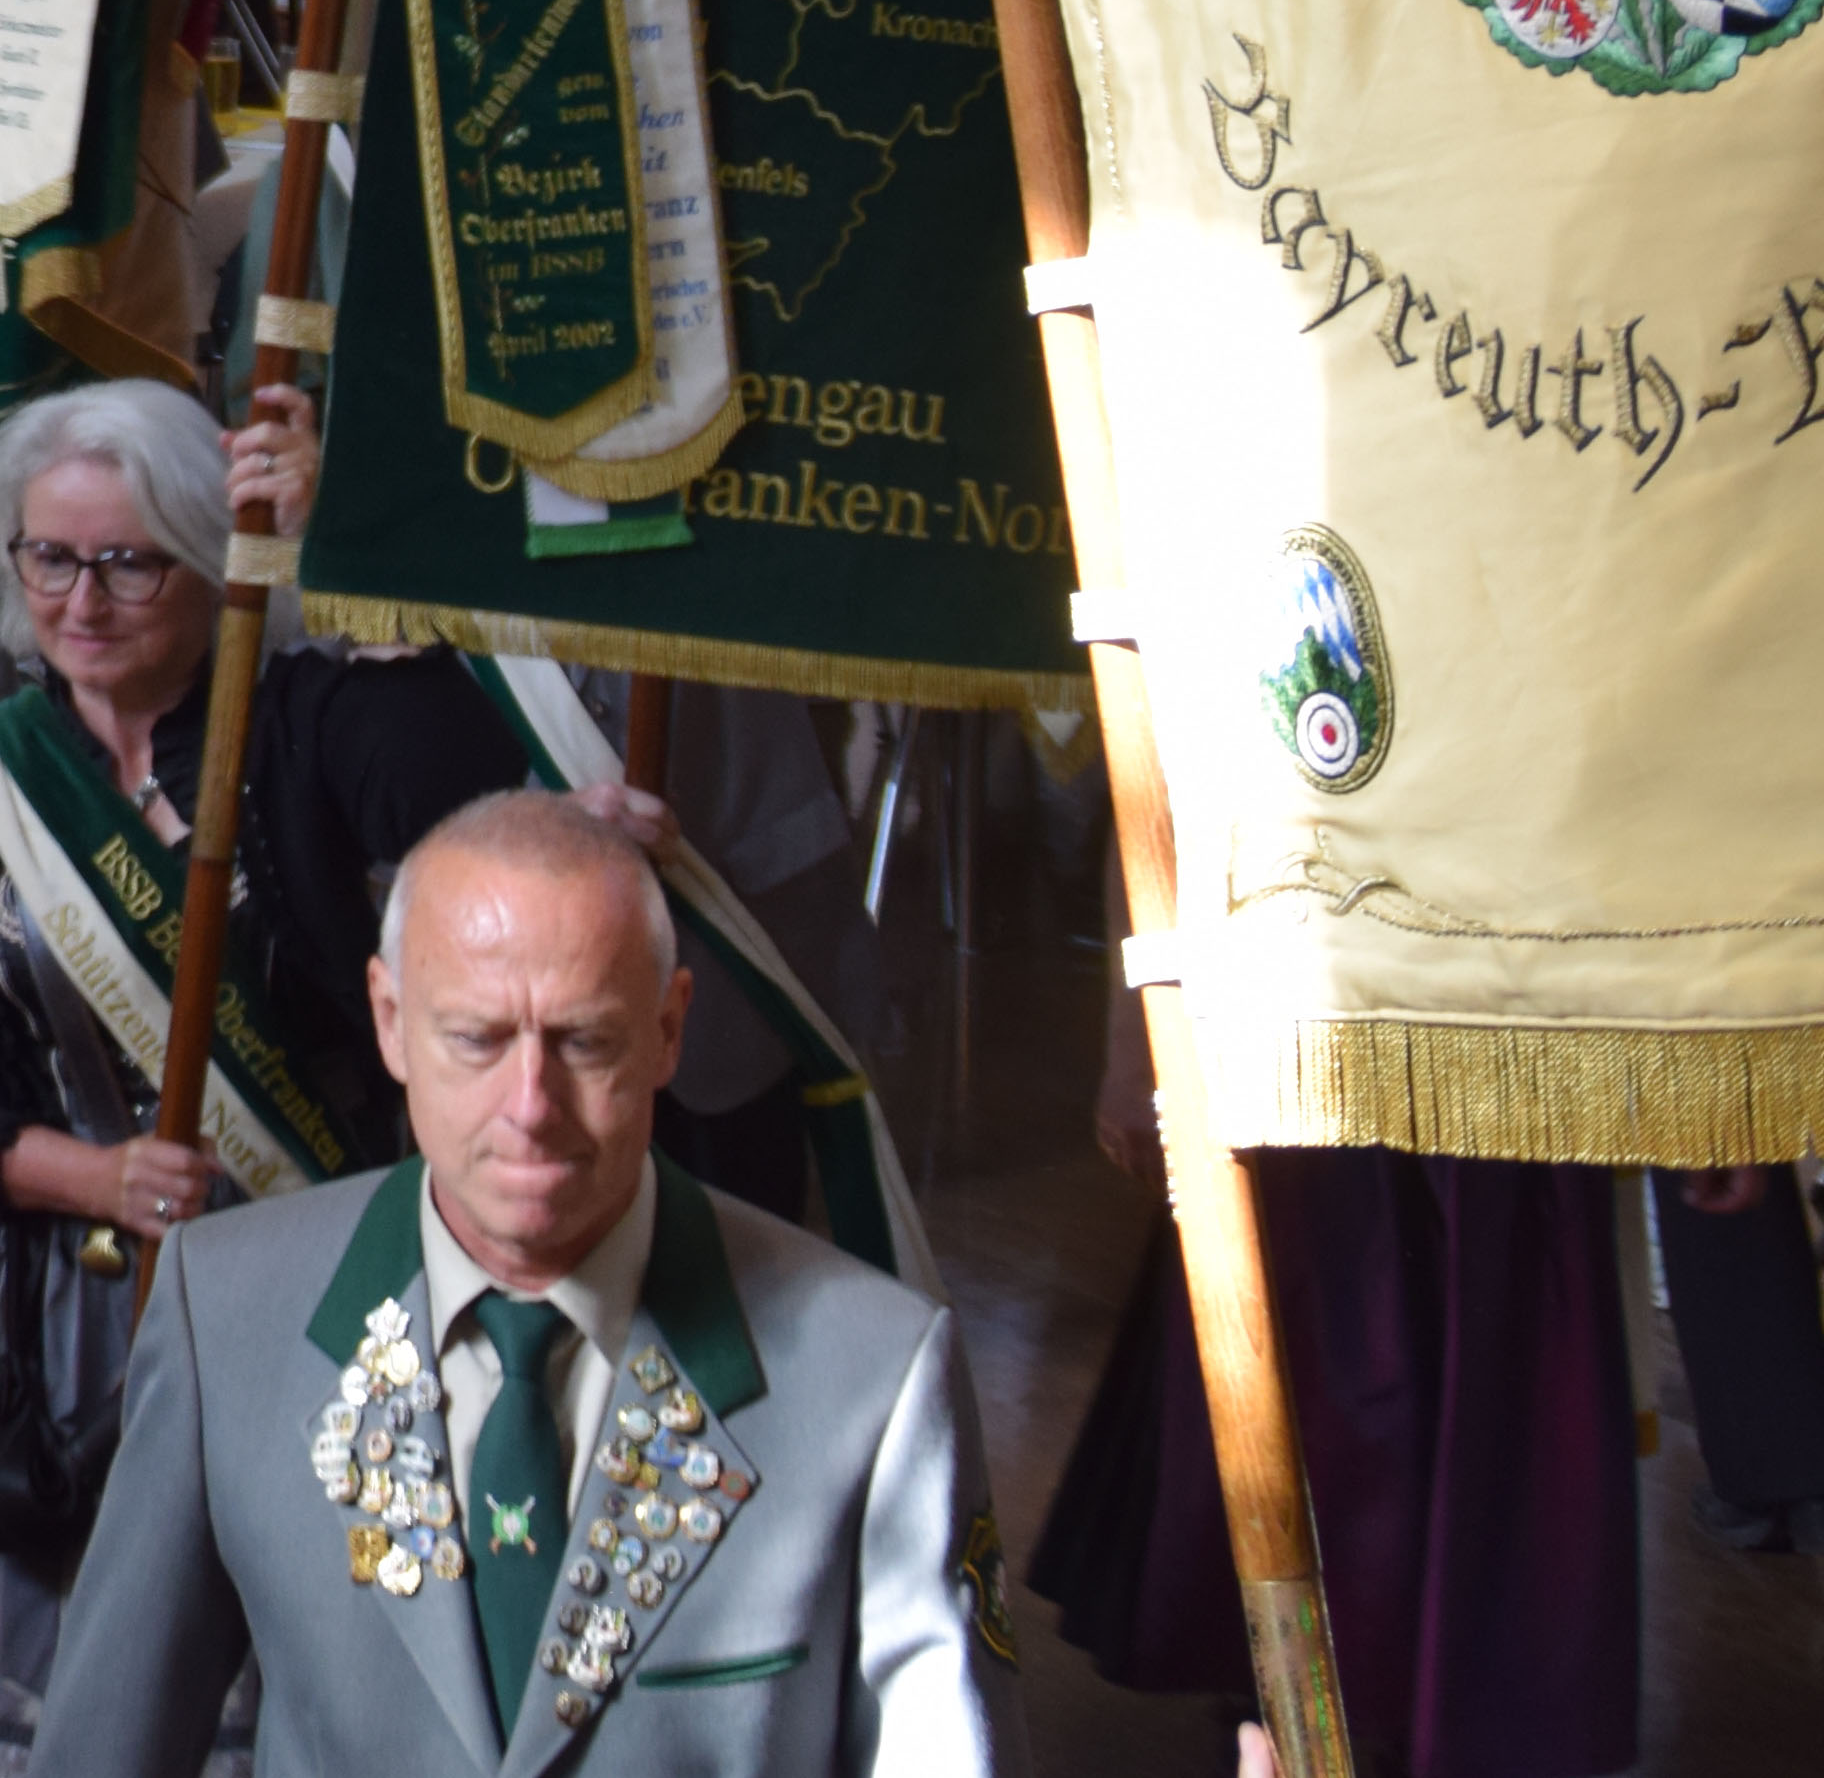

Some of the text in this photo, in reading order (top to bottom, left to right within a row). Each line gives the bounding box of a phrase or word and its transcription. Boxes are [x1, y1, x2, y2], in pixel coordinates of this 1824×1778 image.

[494, 152, 605, 204] Bezirk
[458, 205, 629, 251] Oberfranken
[553, 318, 618, 352] 2002
[91, 832, 164, 921] BSSB
[215, 981, 346, 1175] Oberfranken
[199, 1096, 285, 1193] Nord
